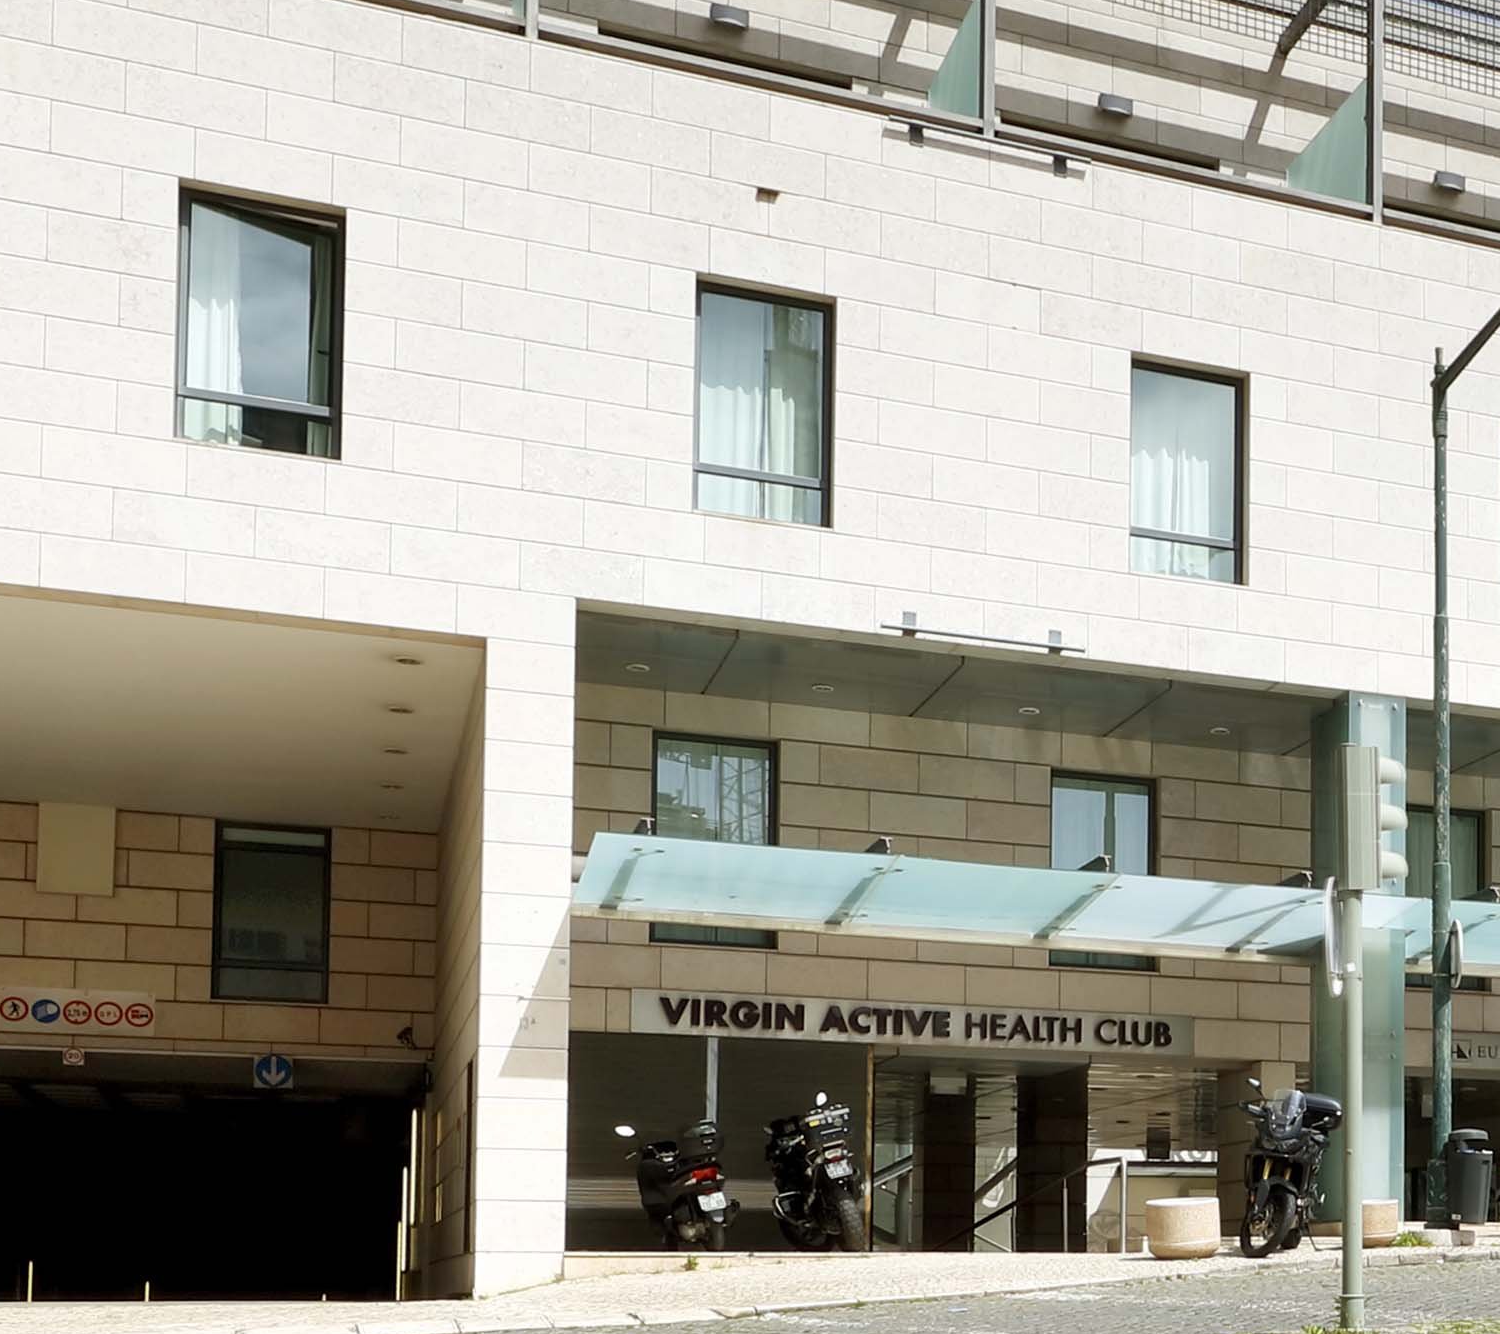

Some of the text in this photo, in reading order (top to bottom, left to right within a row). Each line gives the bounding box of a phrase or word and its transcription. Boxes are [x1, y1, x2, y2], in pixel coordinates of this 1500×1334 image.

[660, 997, 1172, 1047] VIRGIN ACTIVE HEALTH CLUB
